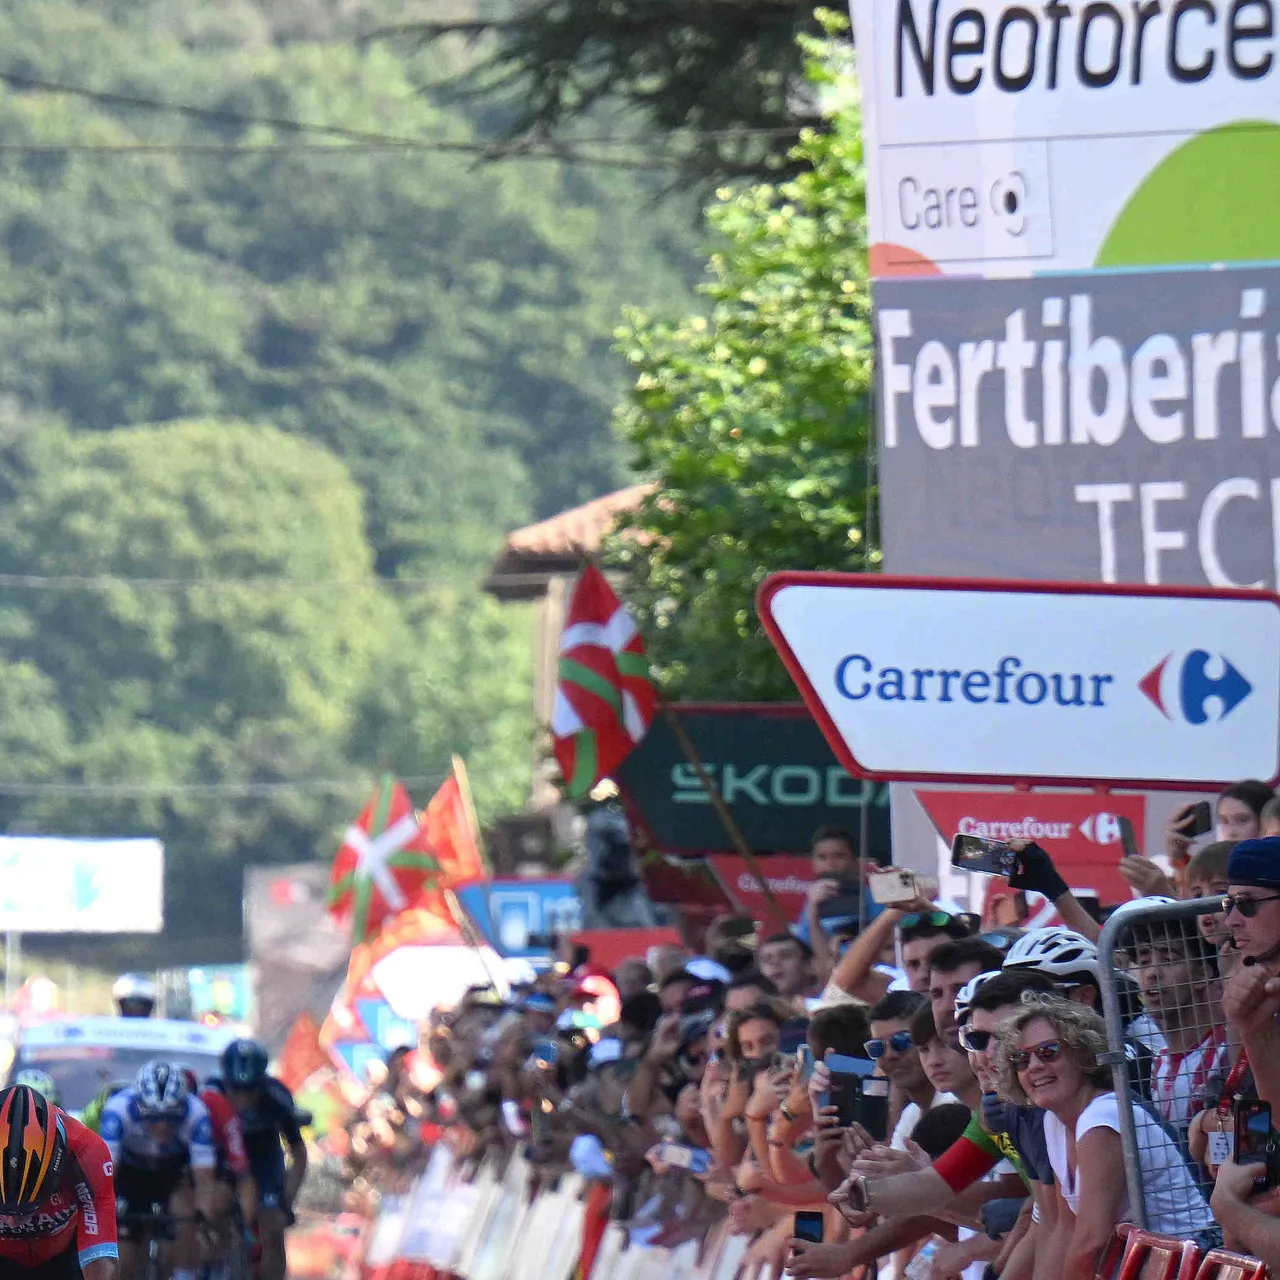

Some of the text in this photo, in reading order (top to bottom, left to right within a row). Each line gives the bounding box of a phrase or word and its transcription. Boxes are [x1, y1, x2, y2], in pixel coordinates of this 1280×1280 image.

[898, 176, 979, 231] Care
[878, 288, 1280, 449] Fertiberi
[833, 653, 1114, 707] Carrefour
[957, 816, 1074, 840] Carrefour
